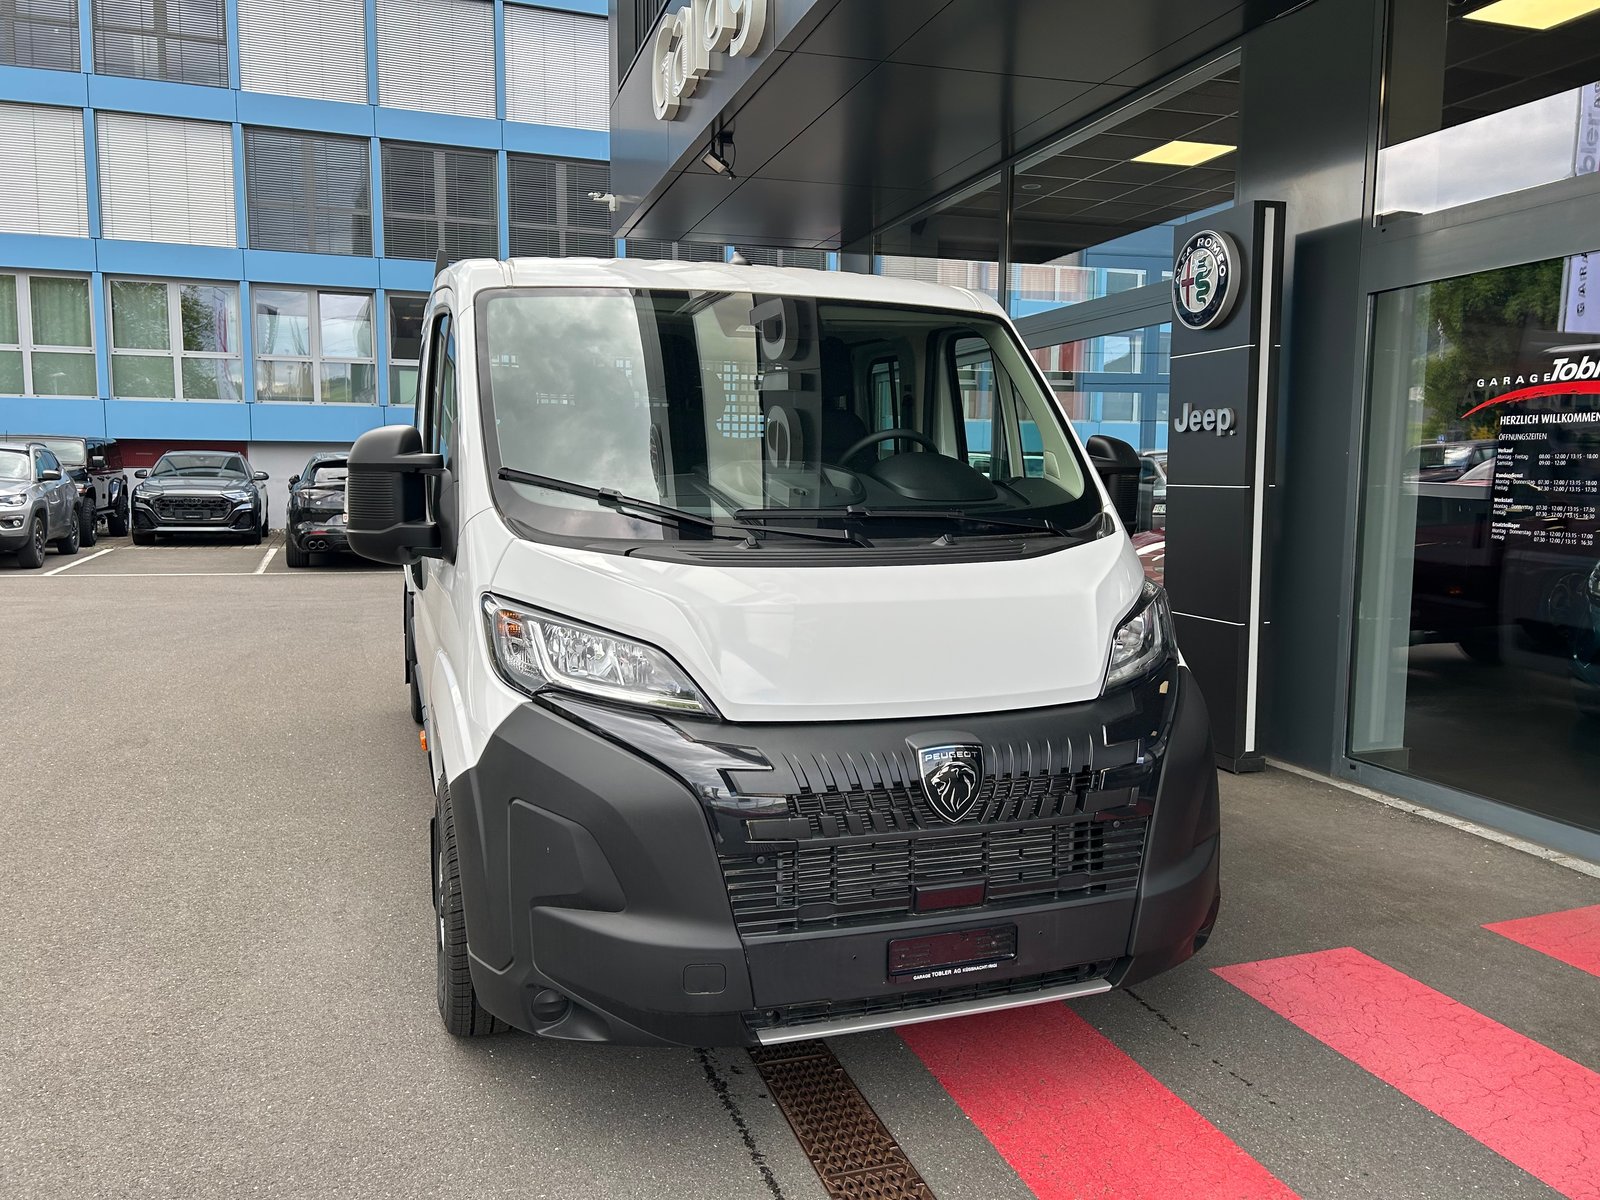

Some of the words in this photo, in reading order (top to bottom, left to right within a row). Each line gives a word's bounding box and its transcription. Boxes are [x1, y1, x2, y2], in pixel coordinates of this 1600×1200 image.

[1174, 246, 1192, 284] ALFA
[1196, 237, 1227, 277] ROMEO
[1476, 372, 1551, 388] GARAGE
[1500, 414, 1538, 426] HERZLICH
[1542, 412, 1600, 424] WILLKOMMEN
[924, 750, 978, 762] PEUGEOT
[932, 968, 952, 978] TOBLER
